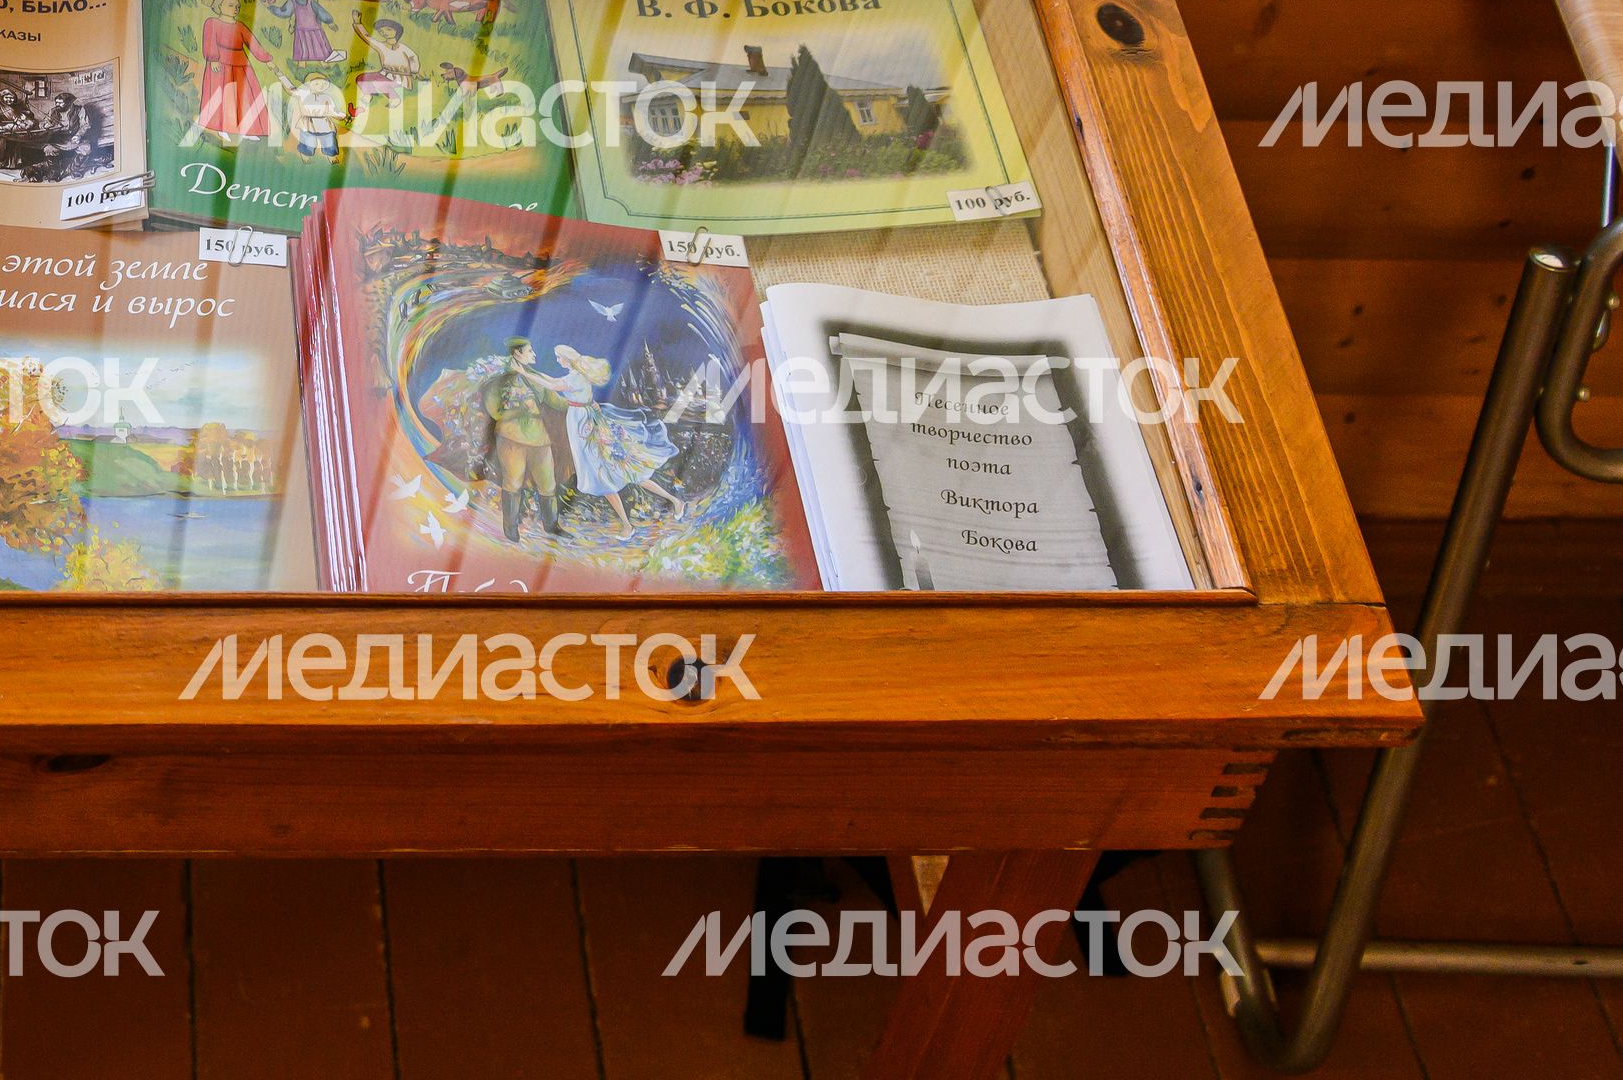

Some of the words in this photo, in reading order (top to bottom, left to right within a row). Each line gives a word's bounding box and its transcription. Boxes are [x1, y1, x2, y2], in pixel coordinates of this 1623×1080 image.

[65, 190, 96, 210] 100
[954, 195, 987, 211] 100
[667, 241, 697, 255] 150
[2, 250, 95, 277] этой
[99, 257, 210, 291] земле
[91, 294, 112, 314] и
[127, 291, 237, 329] вырос
[910, 421, 1034, 448] творчество
[945, 455, 1013, 476] поэта
[940, 487, 1040, 517] Виктора
[960, 528, 1039, 554] Бокова
